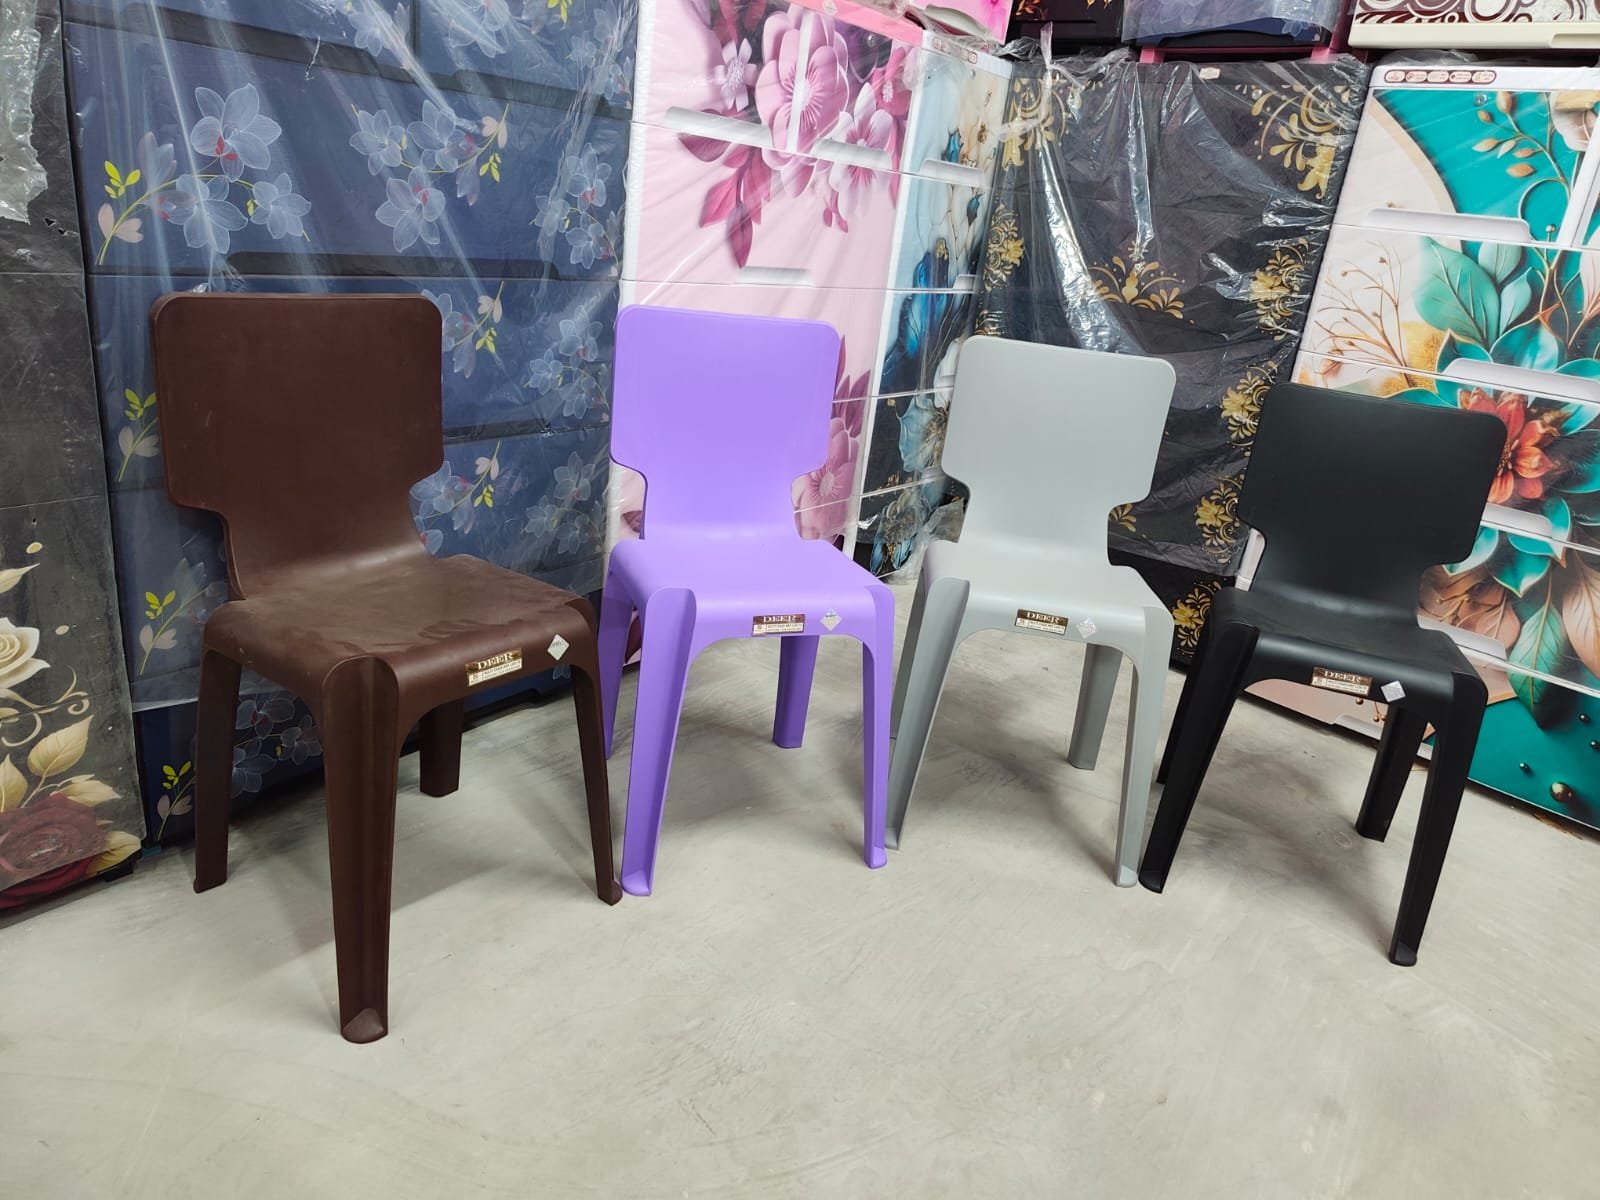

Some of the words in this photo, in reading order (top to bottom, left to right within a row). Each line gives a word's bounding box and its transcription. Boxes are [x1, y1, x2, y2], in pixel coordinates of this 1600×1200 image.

[1026, 611, 1060, 624] DEER
[477, 651, 513, 670] DEER
[1323, 670, 1361, 683] DEER
